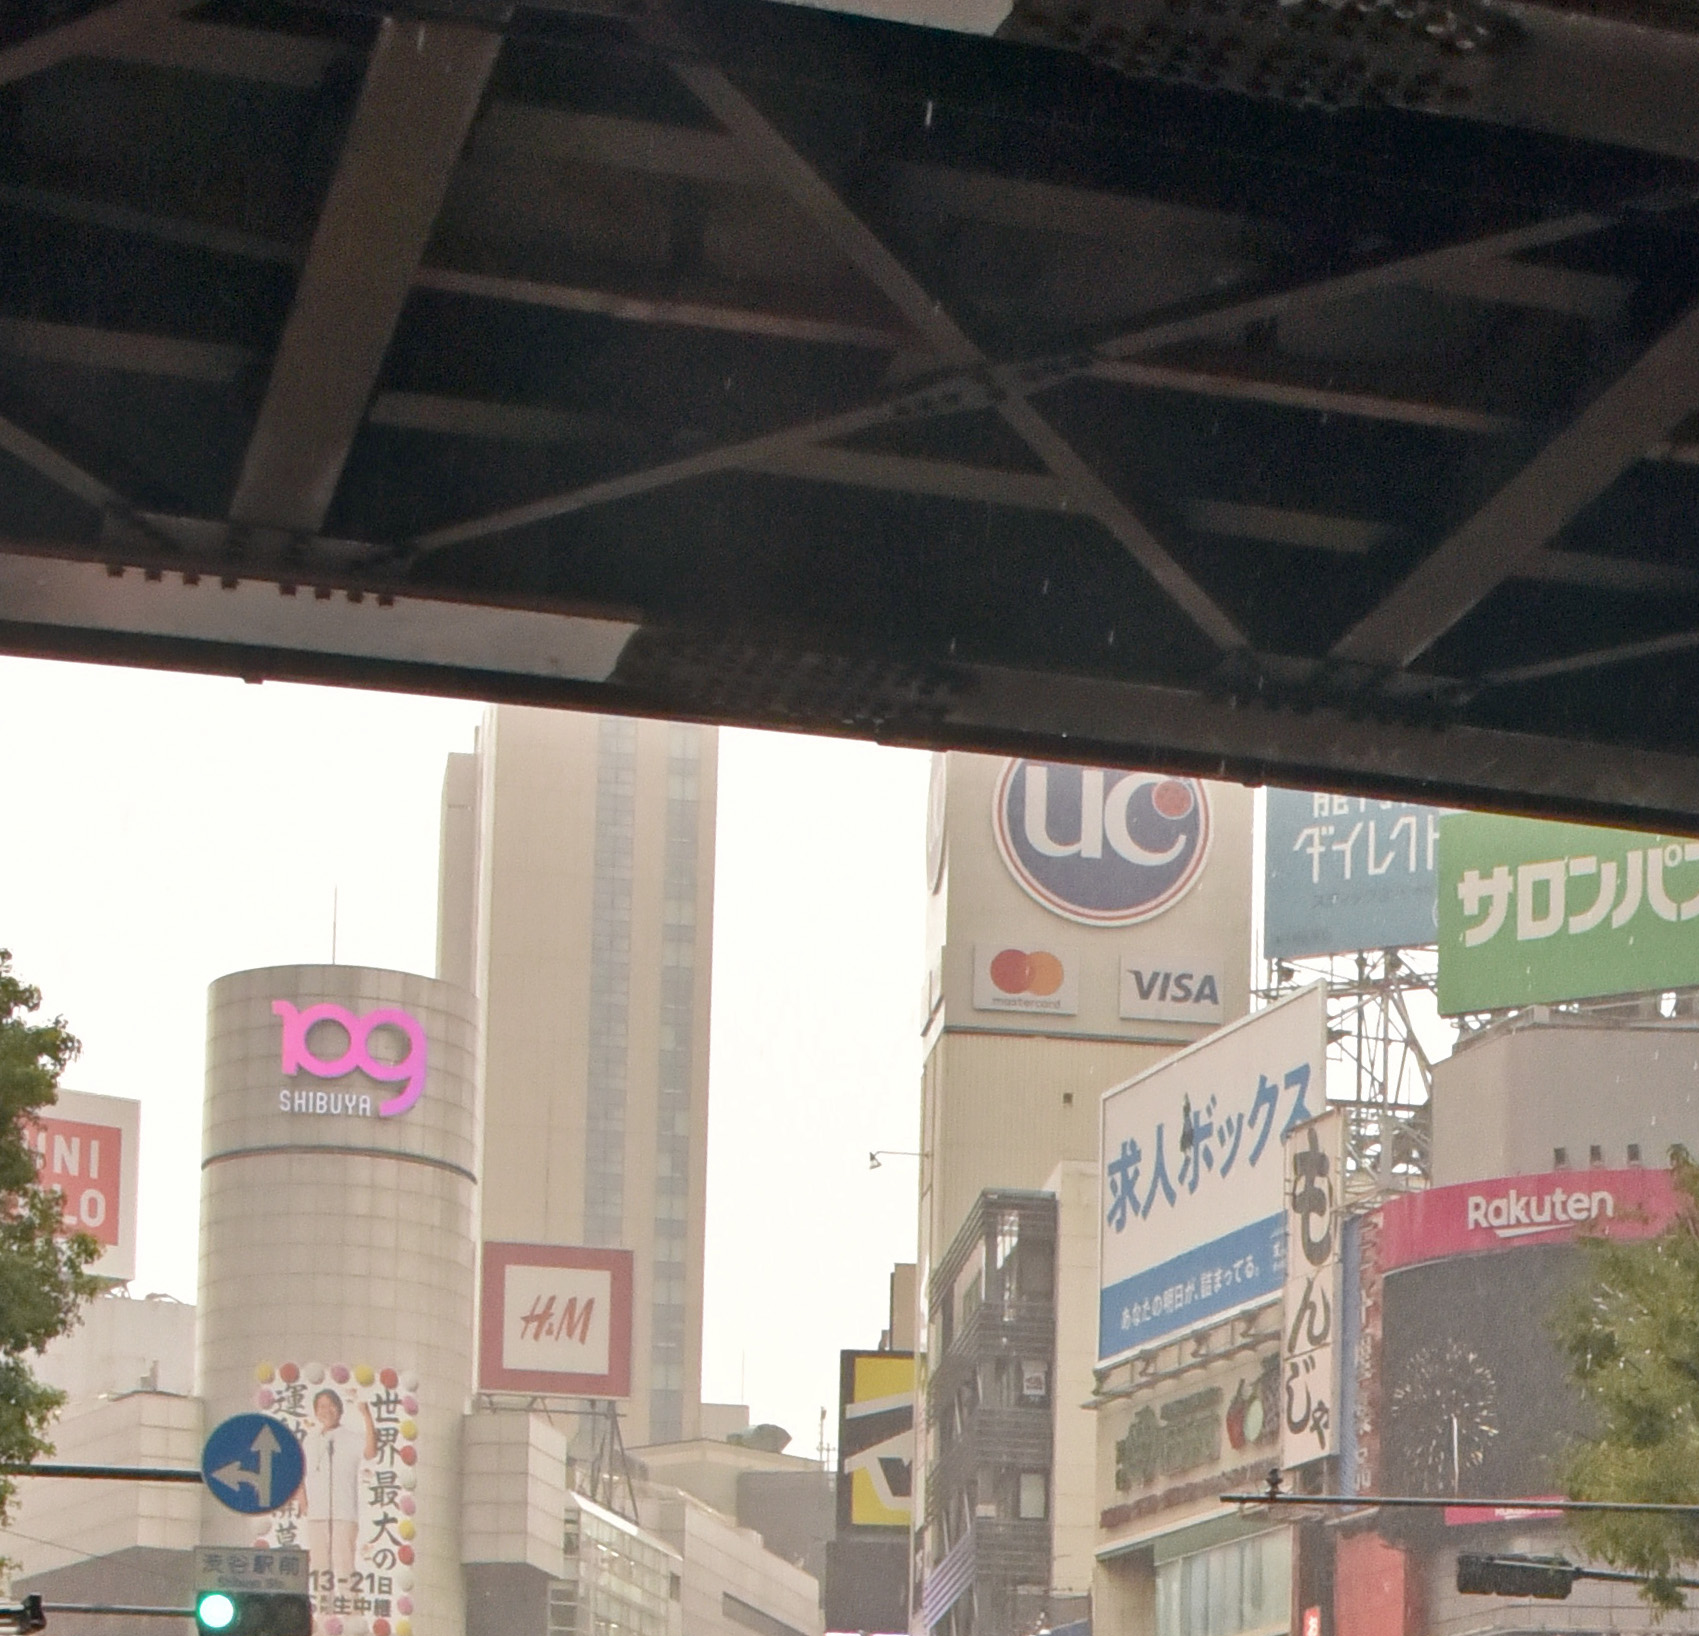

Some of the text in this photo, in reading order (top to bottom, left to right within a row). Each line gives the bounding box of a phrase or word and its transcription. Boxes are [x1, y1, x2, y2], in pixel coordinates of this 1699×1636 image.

[1127, 969, 1220, 1005] VISA
[271, 999, 428, 1118] 109
[279, 1089, 371, 1117] SHIBUYA
[1106, 1062, 1313, 1235] 求人ボックス
[1467, 1186, 1615, 1232] Rakuten
[519, 1295, 595, 1345] H&M
[1284, 1127, 1334, 1451] もんじゃ
[367, 1386, 401, 1572] 世界最大の
